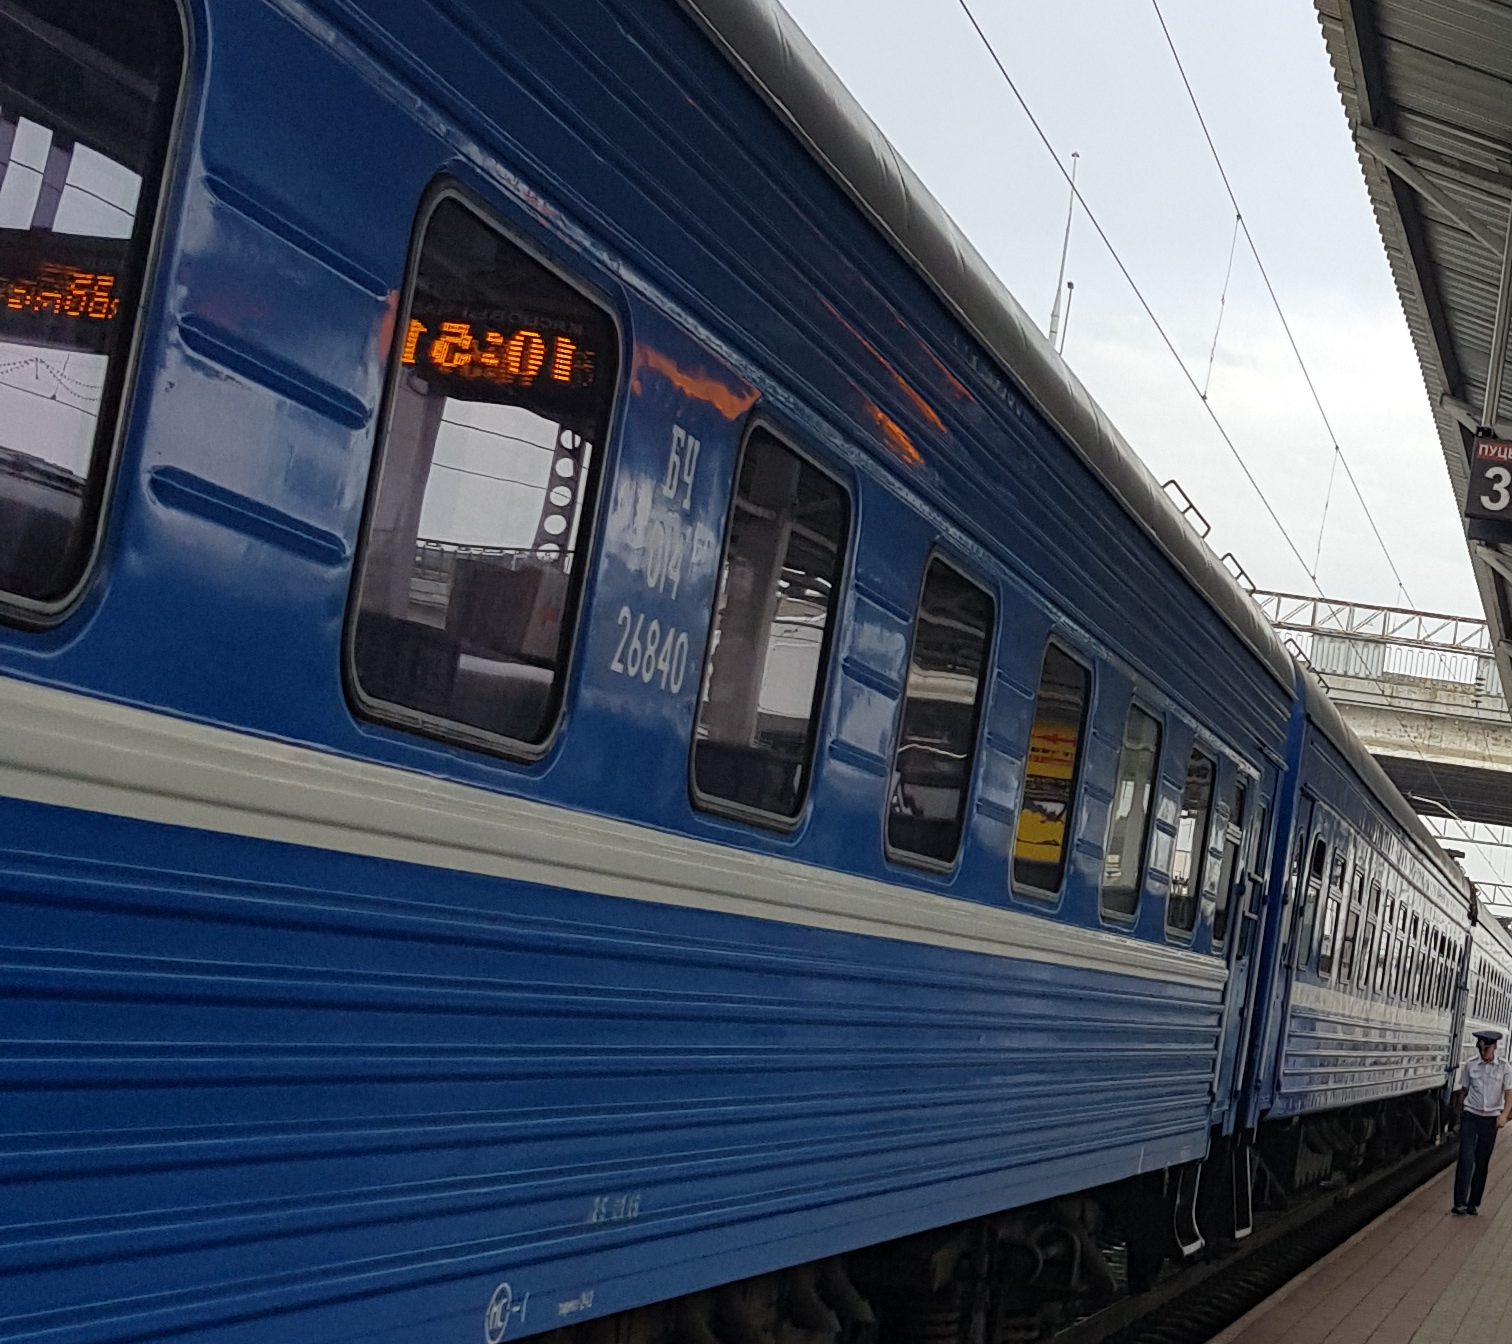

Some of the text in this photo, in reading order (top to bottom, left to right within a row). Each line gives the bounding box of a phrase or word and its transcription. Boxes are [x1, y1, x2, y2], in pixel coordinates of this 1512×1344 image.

[662, 424, 700, 510] БЧ
[1480, 466, 1512, 511] 3
[610, 605, 689, 694] 26840
